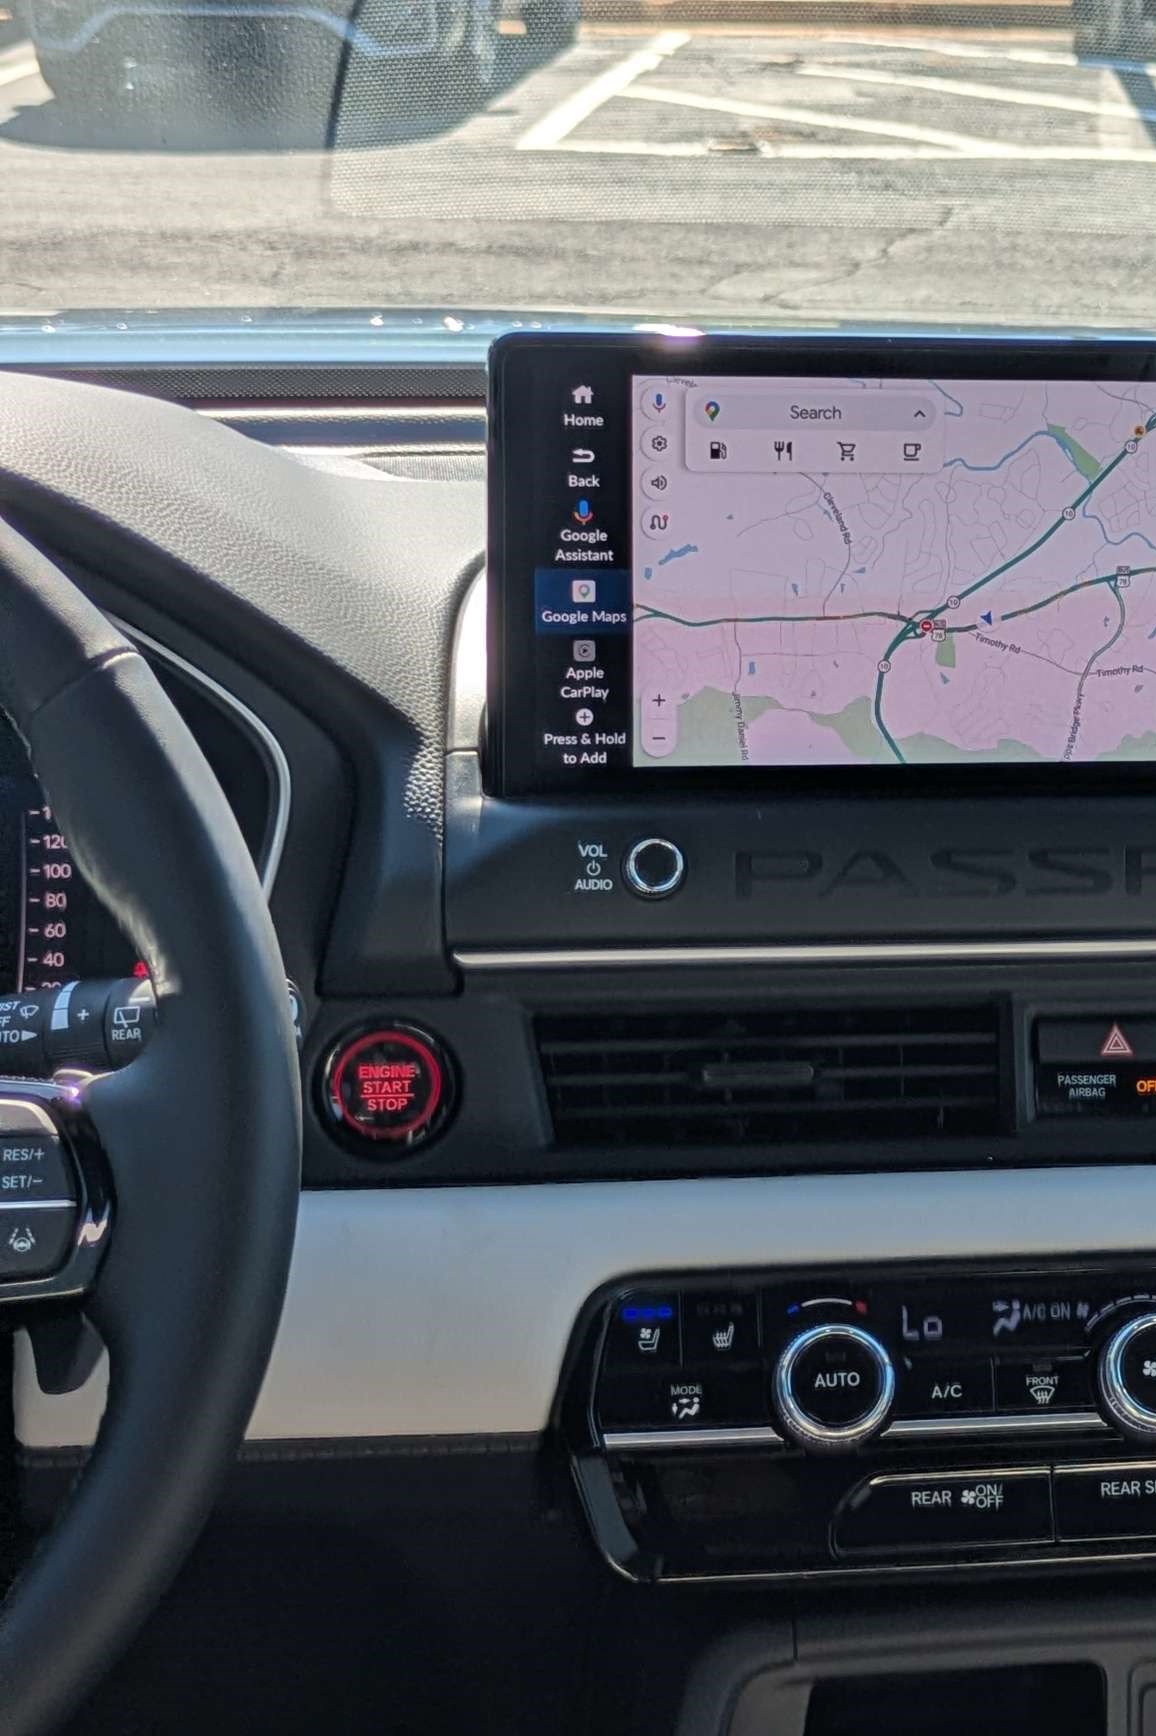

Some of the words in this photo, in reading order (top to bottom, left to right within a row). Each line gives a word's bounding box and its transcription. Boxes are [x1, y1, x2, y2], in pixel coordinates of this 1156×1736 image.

[563, 413, 604, 426] Home
[790, 404, 842, 420] Search
[568, 474, 601, 487] Back
[560, 529, 608, 544] Google
[555, 548, 615, 562] Assistant
[541, 609, 589, 625] Google
[592, 610, 627, 625] Maps
[975, 632, 1008, 652] Timothy
[1008, 643, 1021, 655] Rd
[566, 666, 605, 681] Apple
[1096, 667, 1130, 678] Timothy
[1132, 664, 1144, 673] Rd
[560, 686, 609, 701] CarPlay
[544, 733, 578, 746] Press
[581, 733, 592, 746] &
[595, 732, 627, 745] Hold
[563, 753, 577, 765] to
[580, 752, 607, 765] Add
[578, 843, 608, 858] VOL
[42, 863, 72, 879] 100
[574, 878, 613, 891] AUDIO
[44, 893, 68, 909] 80
[44, 922, 67, 938] 60
[42, 952, 65, 967] 40
[111, 1028, 142, 1041] REAR
[359, 1064, 416, 1079] ENGINE
[363, 1080, 411, 1094] START
[1057, 1074, 1117, 1087] PASSENGER
[1069, 1087, 1106, 1099] AIRBAG
[367, 1098, 408, 1112] STOP
[1050, 1302, 1071, 1320] ON
[814, 1371, 861, 1389] AUTO
[1026, 1375, 1059, 1386] FRONT
[670, 1384, 703, 1396] MODE
[931, 1384, 963, 1400] A/C
[975, 1484, 1003, 1497] ON/
[1100, 1480, 1142, 1498] REAR
[911, 1490, 952, 1506] REAR
[976, 1496, 1004, 1510] OFF
